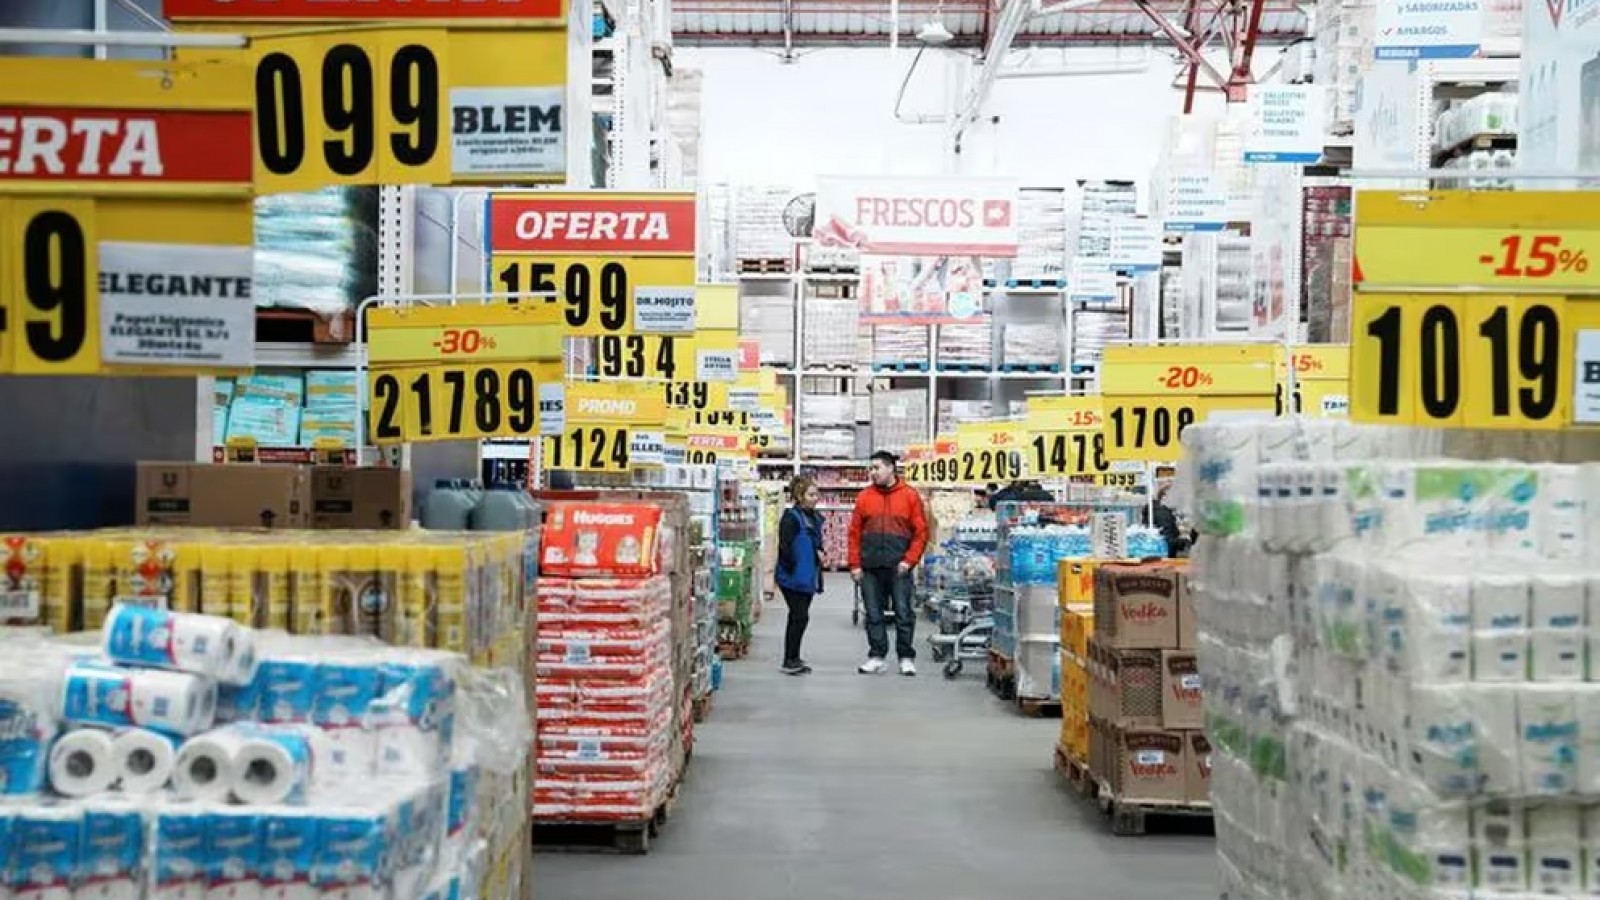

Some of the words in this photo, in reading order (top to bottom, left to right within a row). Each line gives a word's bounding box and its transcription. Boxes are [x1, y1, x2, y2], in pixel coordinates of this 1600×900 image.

[1405, 1, 1479, 11] SABORIZADAS
[1397, 26, 1448, 35] AMARGOS
[255, 43, 439, 176] 099
[453, 105, 562, 134] BLEM
[515, 211, 670, 240] OFERTA
[855, 197, 974, 228] FRESCOS
[1479, 234, 1588, 277] -15%
[0, 210, 86, 362] 9
[97, 272, 252, 298] ELEGANTE
[500, 262, 627, 330] 1599
[433, 329, 497, 354] -30%
[1158, 366, 1213, 388] -20%
[1367, 304, 1560, 420] 1019
[374, 368, 535, 438] 21789
[579, 400, 636, 414] PROMO
[550, 428, 628, 468] 1124
[1032, 433, 1109, 472] 1478
[963, 450, 1020, 480] 2209
[1121, 602, 1168, 620] Vodka
